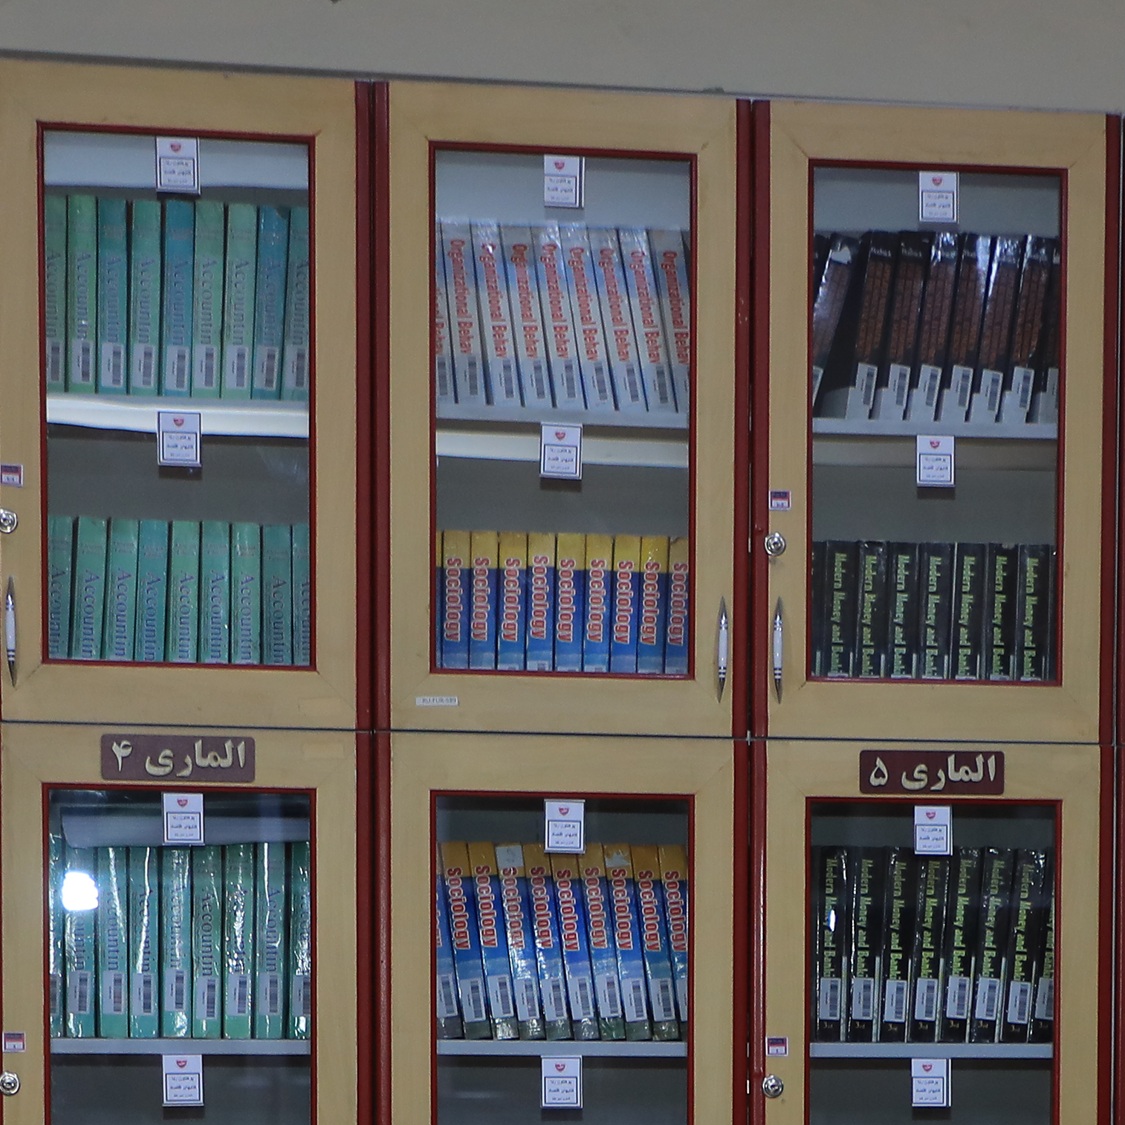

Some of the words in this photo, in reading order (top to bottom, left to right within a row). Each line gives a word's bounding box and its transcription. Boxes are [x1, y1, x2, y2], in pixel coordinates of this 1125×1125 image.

[82, 570, 100, 658] Accountin
[115, 568, 131, 657] Accountin
[179, 572, 194, 659] Accountin
[211, 570, 226, 659] Accountin
[272, 576, 287, 664] Accountin
[444, 557, 463, 642] Sociology
[471, 557, 490, 642] Sociology
[502, 558, 521, 642] Sociology
[530, 555, 549, 639] Sociology
[557, 559, 576, 642] Sociology
[587, 559, 606, 643] Sociology
[614, 560, 634, 644] Sociology
[640, 561, 660, 645] Sociology
[668, 563, 688, 646] Sociology
[111, 739, 132, 772] ۴
[145, 739, 245, 777] الماری
[869, 756, 889, 787] ۵
[901, 753, 996, 791] الماری
[447, 867, 471, 949] Sociology
[475, 865, 497, 947] Sociology
[531, 866, 553, 948] Sociology
[557, 869, 580, 951] Sociology
[585, 866, 608, 949] Sociology
[611, 868, 633, 950] Sociology
[639, 870, 661, 952] Sociology
[665, 871, 687, 951] Sociology
